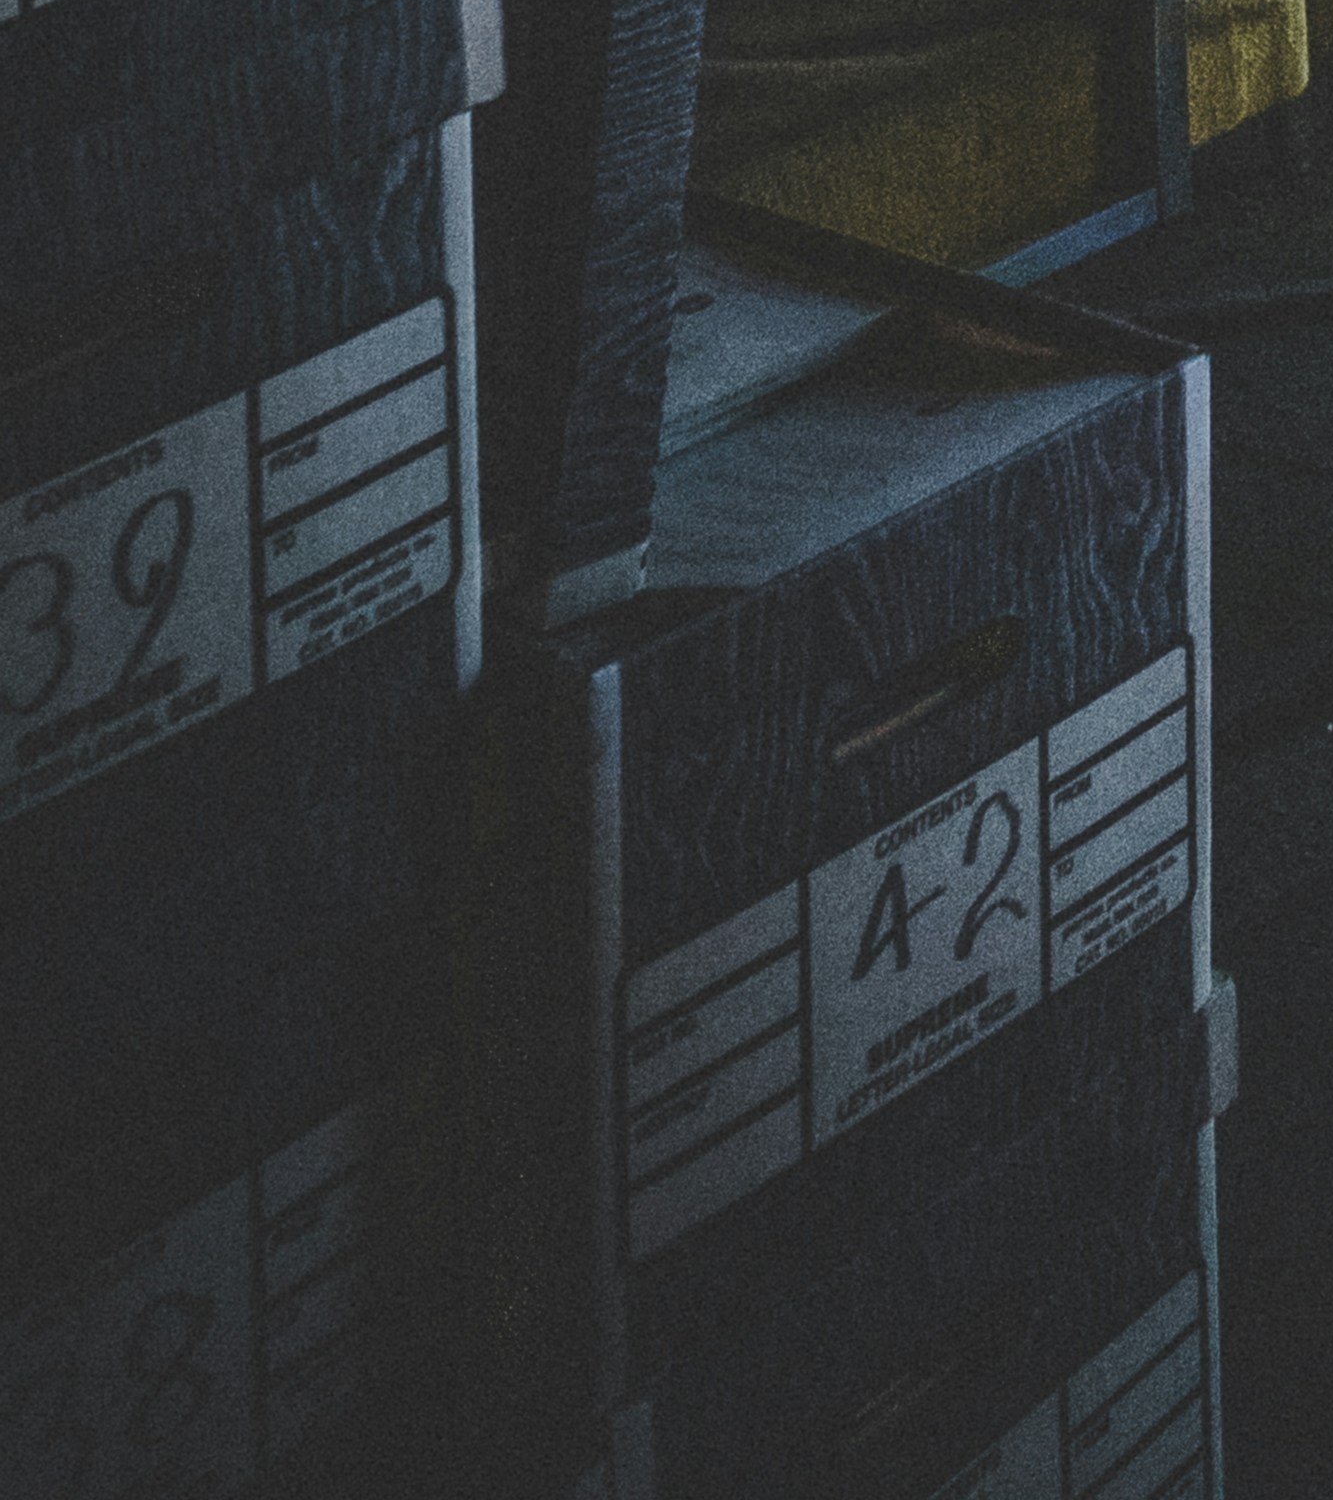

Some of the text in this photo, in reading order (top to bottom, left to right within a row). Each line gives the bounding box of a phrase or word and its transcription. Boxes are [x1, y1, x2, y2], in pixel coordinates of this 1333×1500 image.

[0, 487, 195, 716] 39
[850, 790, 1028, 982] 42
[873, 781, 978, 861] CONTENTS
[866, 973, 990, 1075] SUPREME
